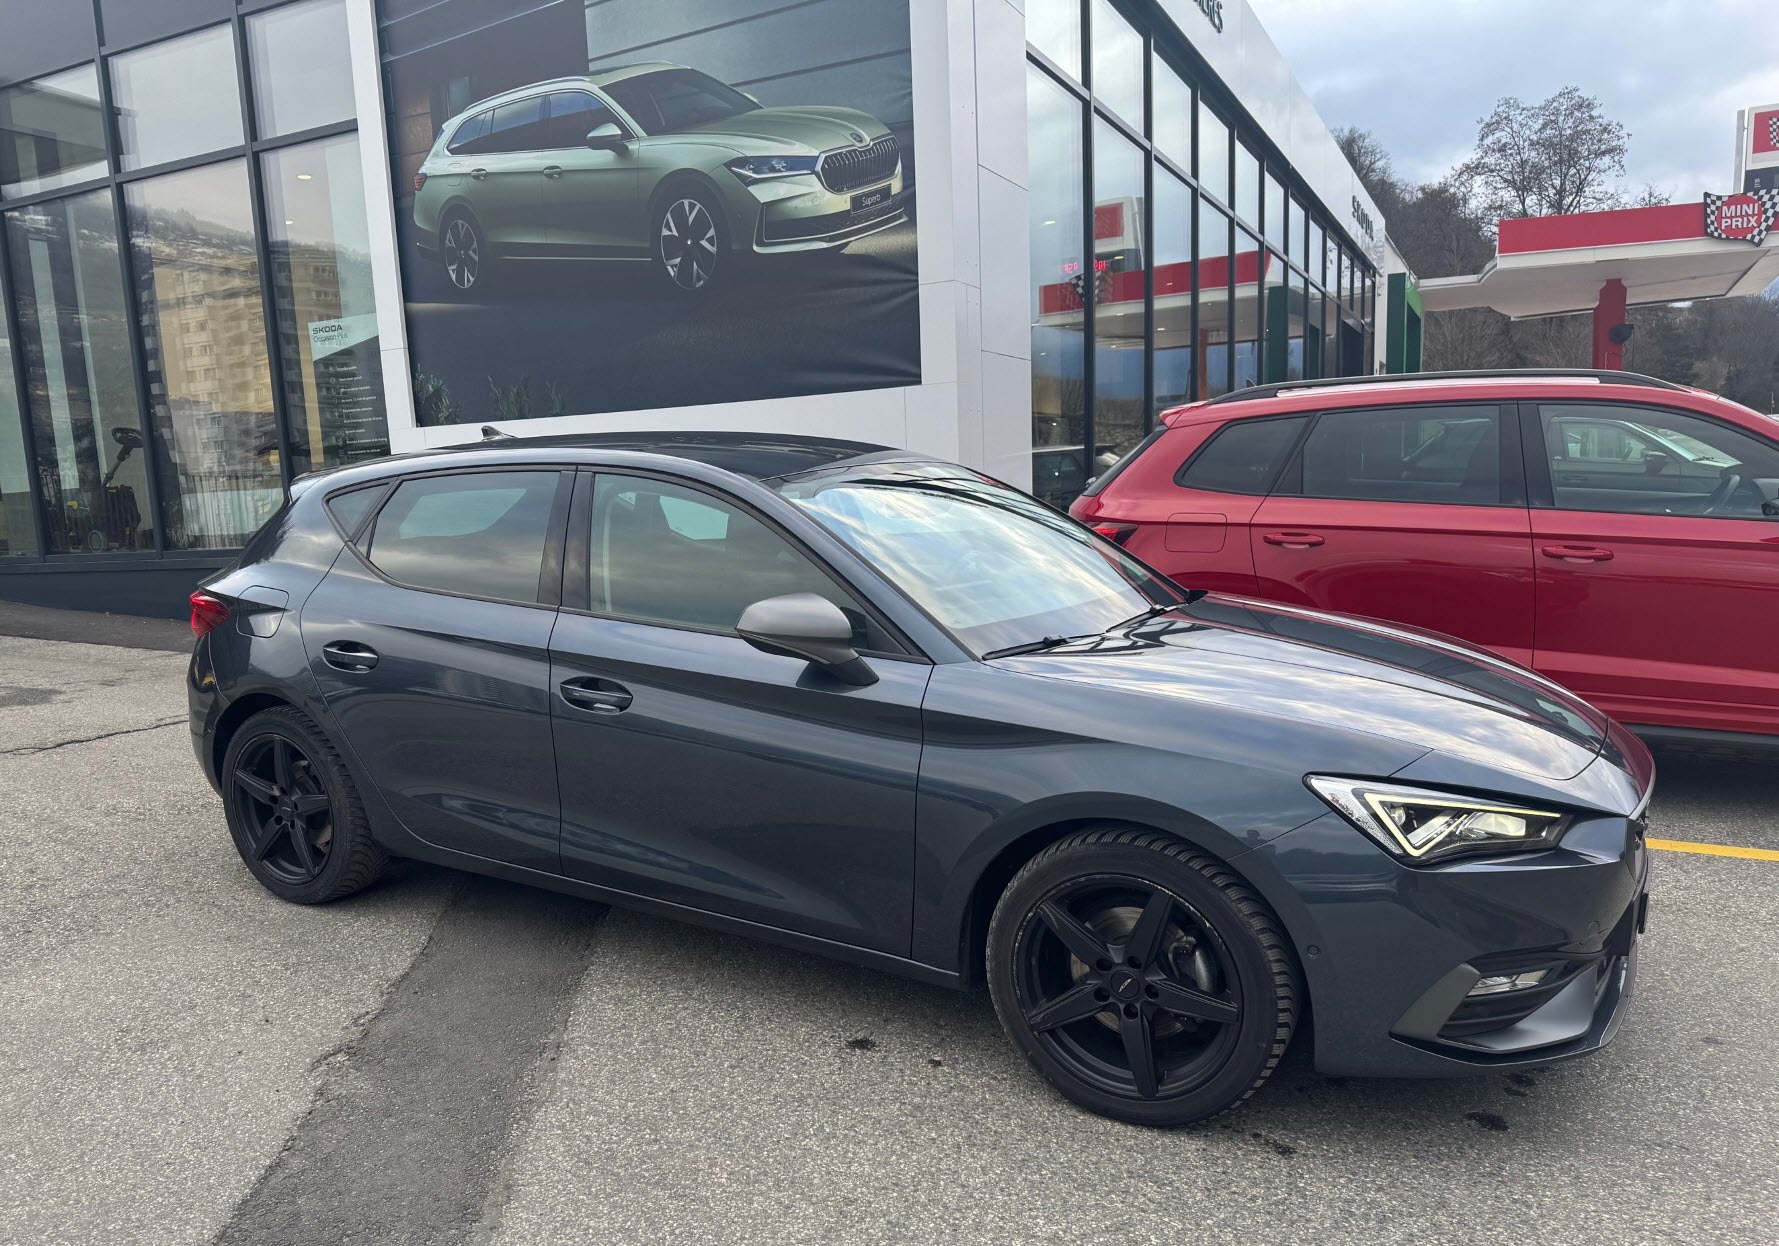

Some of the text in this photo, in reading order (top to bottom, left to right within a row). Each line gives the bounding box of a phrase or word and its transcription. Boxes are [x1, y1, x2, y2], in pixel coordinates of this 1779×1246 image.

[862, 193, 881, 206] Superb
[1721, 203, 1759, 217] MINI
[1721, 216, 1759, 230] PRIX
[313, 335, 337, 343] Occasion
